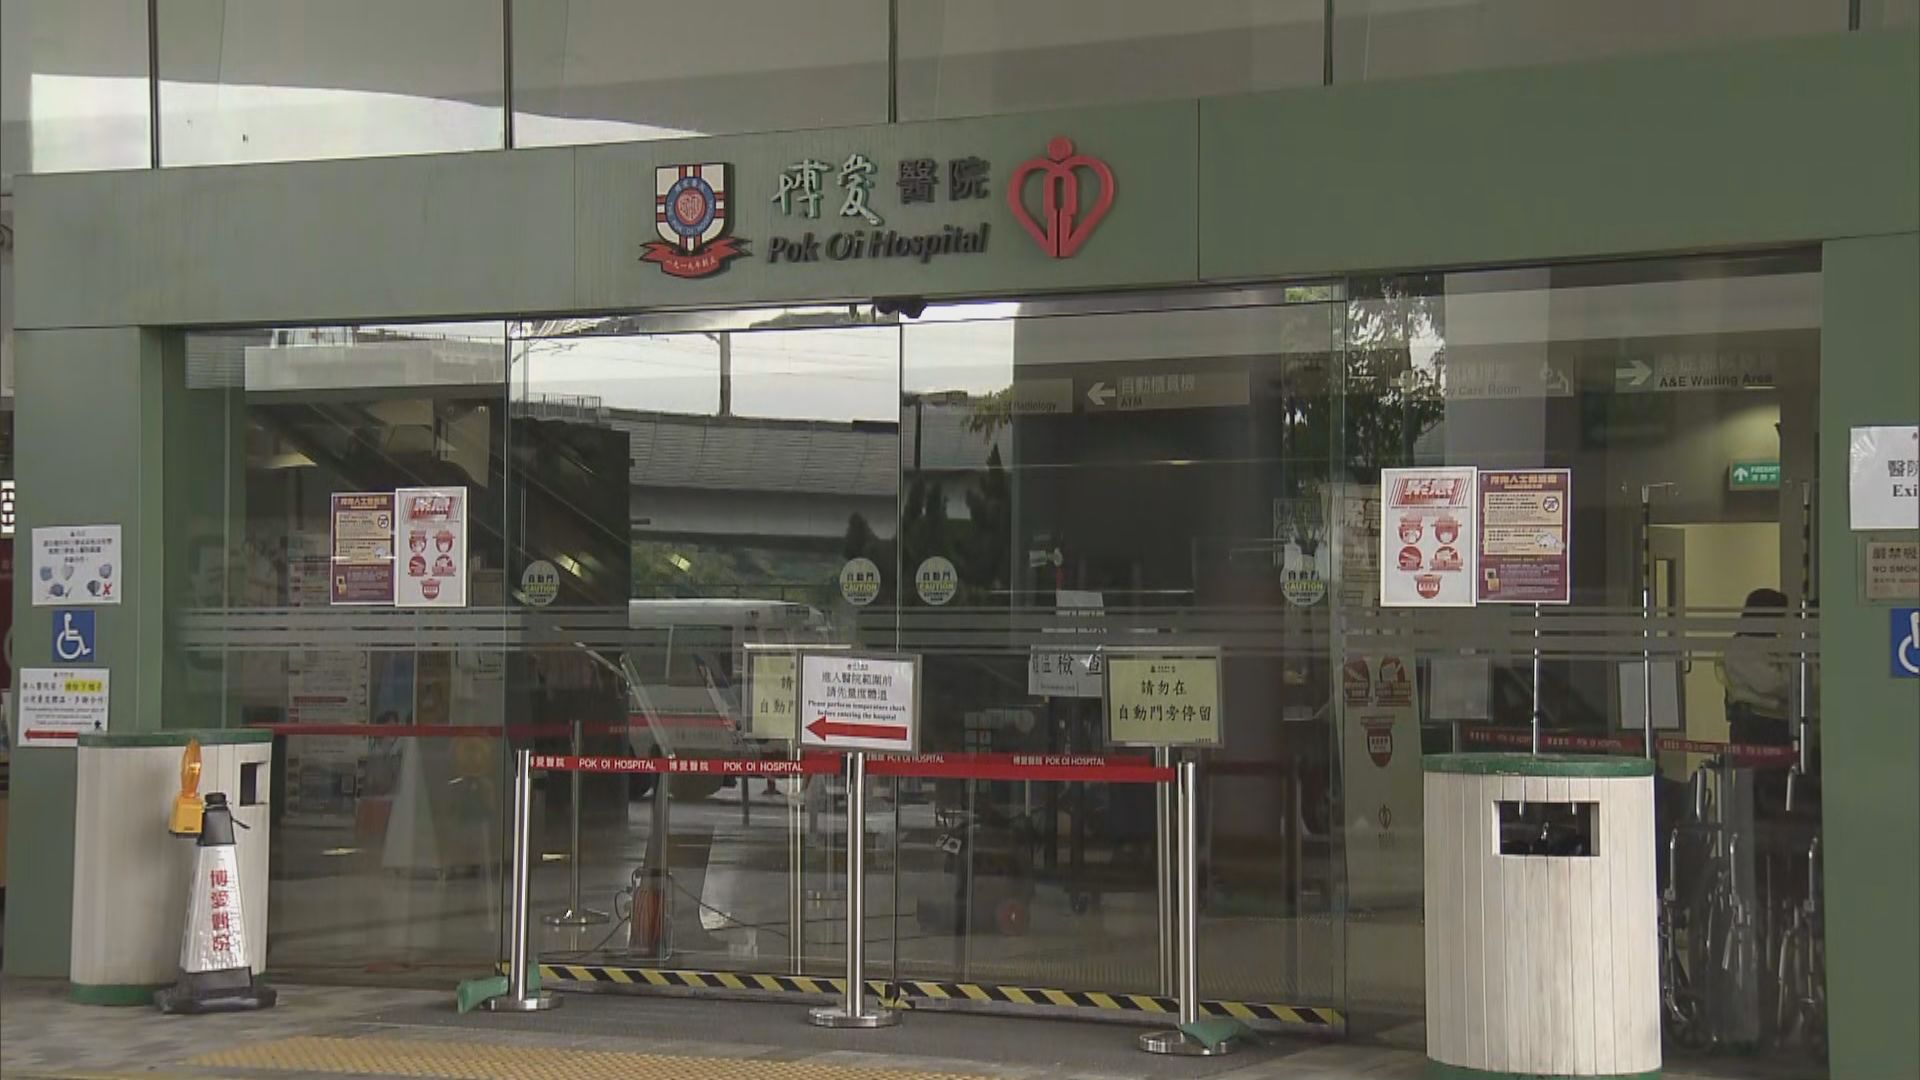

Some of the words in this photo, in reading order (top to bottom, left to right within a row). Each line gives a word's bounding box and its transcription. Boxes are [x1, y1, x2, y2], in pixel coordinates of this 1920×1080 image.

[767, 232, 821, 264] Pok
[868, 222, 991, 264] Hospital
[1659, 374, 1687, 388] A&E
[1691, 373, 1738, 387] Waiting
[1743, 372, 1774, 384] Area
[1488, 383, 1521, 395] Room
[1872, 565, 1887, 573] NO
[524, 584, 558, 593] CAUTION
[843, 583, 877, 592] CAUTION
[919, 583, 955, 591] CAUTION
[1284, 582, 1323, 591] CAUTION
[1141, 678, 1188, 696] 請勿在
[827, 701, 852, 709] perform
[837, 711, 862, 719] entering
[1119, 704, 1212, 722] 自動門旁停留
[579, 758, 598, 769] POK
[601, 758, 611, 769] OI
[614, 759, 656, 770] HOSPITAL
[723, 761, 743, 772] POK
[746, 762, 756, 772] OI
[760, 762, 803, 772] HOSPITAL
[1045, 757, 1061, 766] POK
[1071, 757, 1105, 767] HOSPITAL
